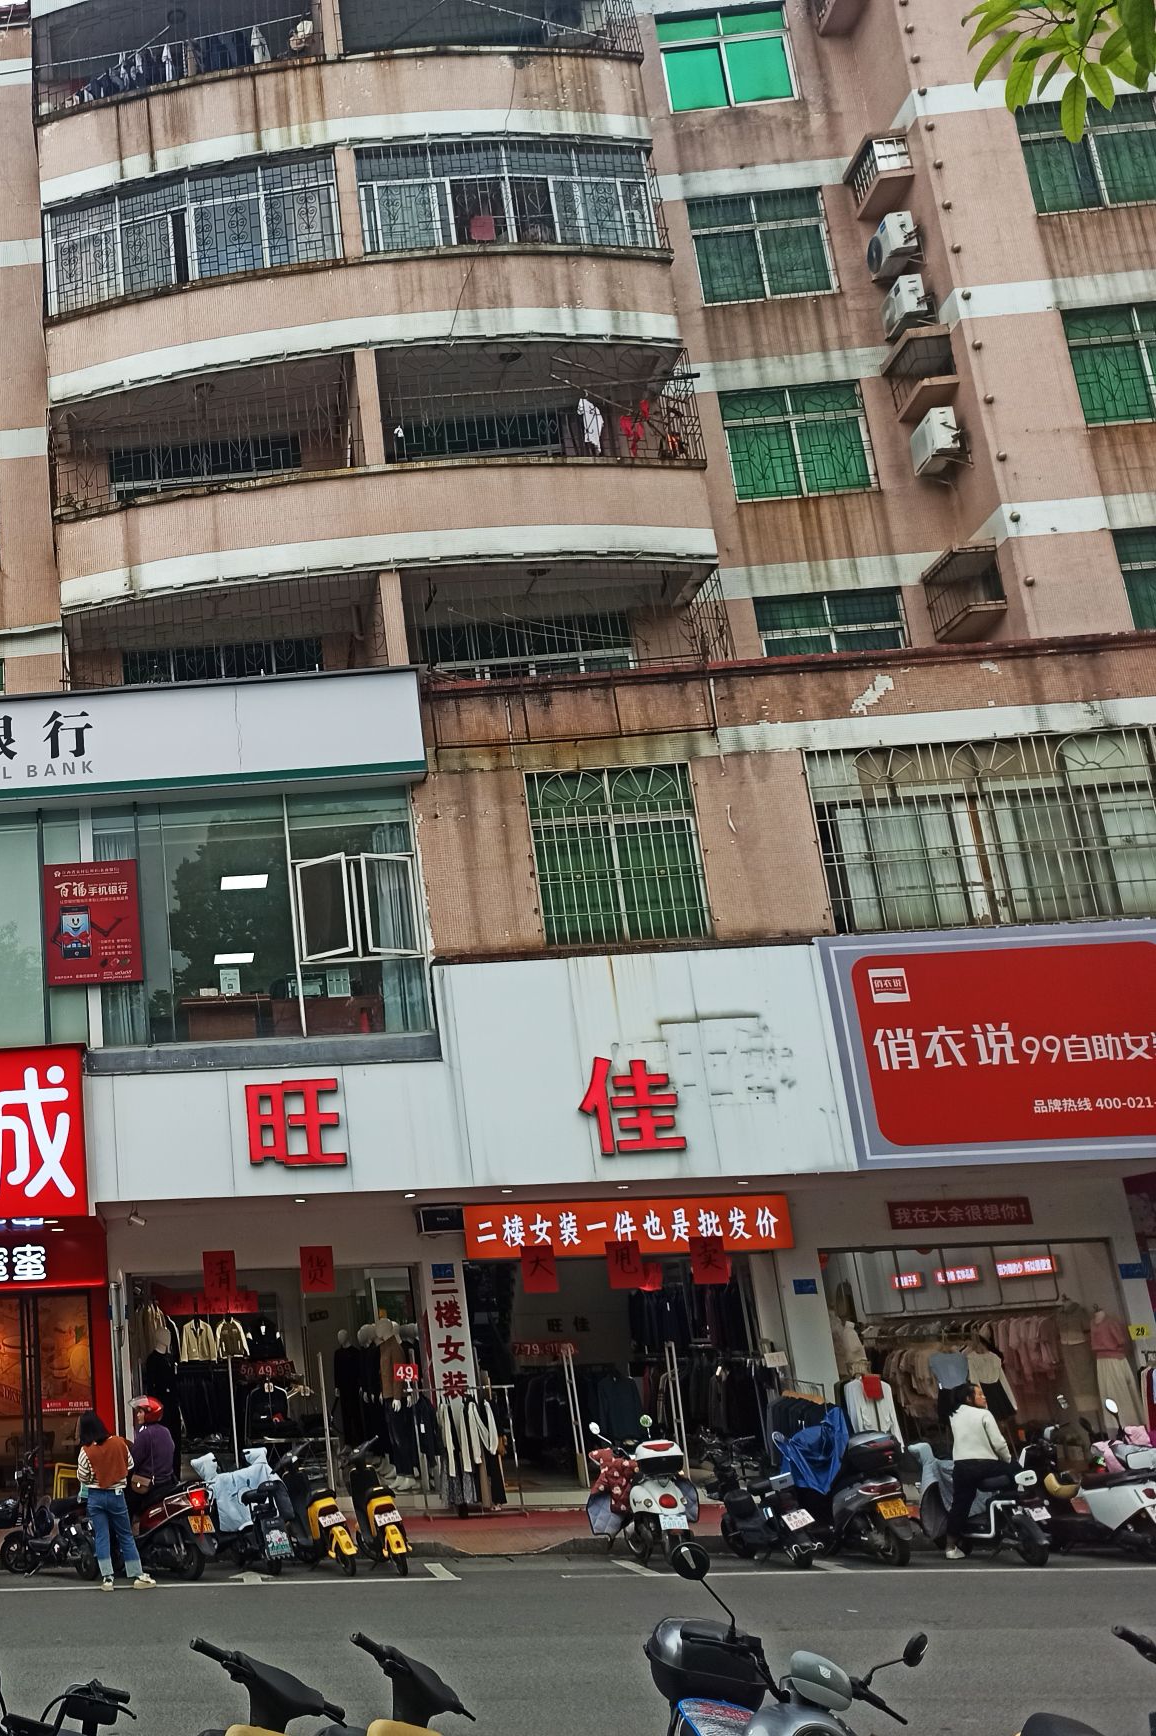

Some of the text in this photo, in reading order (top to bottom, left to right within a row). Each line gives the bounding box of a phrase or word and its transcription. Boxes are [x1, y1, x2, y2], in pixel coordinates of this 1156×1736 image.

[26, 760, 95, 778] BANK
[872, 1022, 1156, 1071] 俏衣说 99自助女
[245, 1056, 688, 1169] 旺 佳
[1033, 1097, 1093, 1114] 品牌热线
[477, 1206, 780, 1248] 二楼女装一件也是批发价
[209, 1255, 326, 1292] 清 货
[432, 1278, 468, 1401] 二楼女装
[396, 1365, 414, 1380] 49
